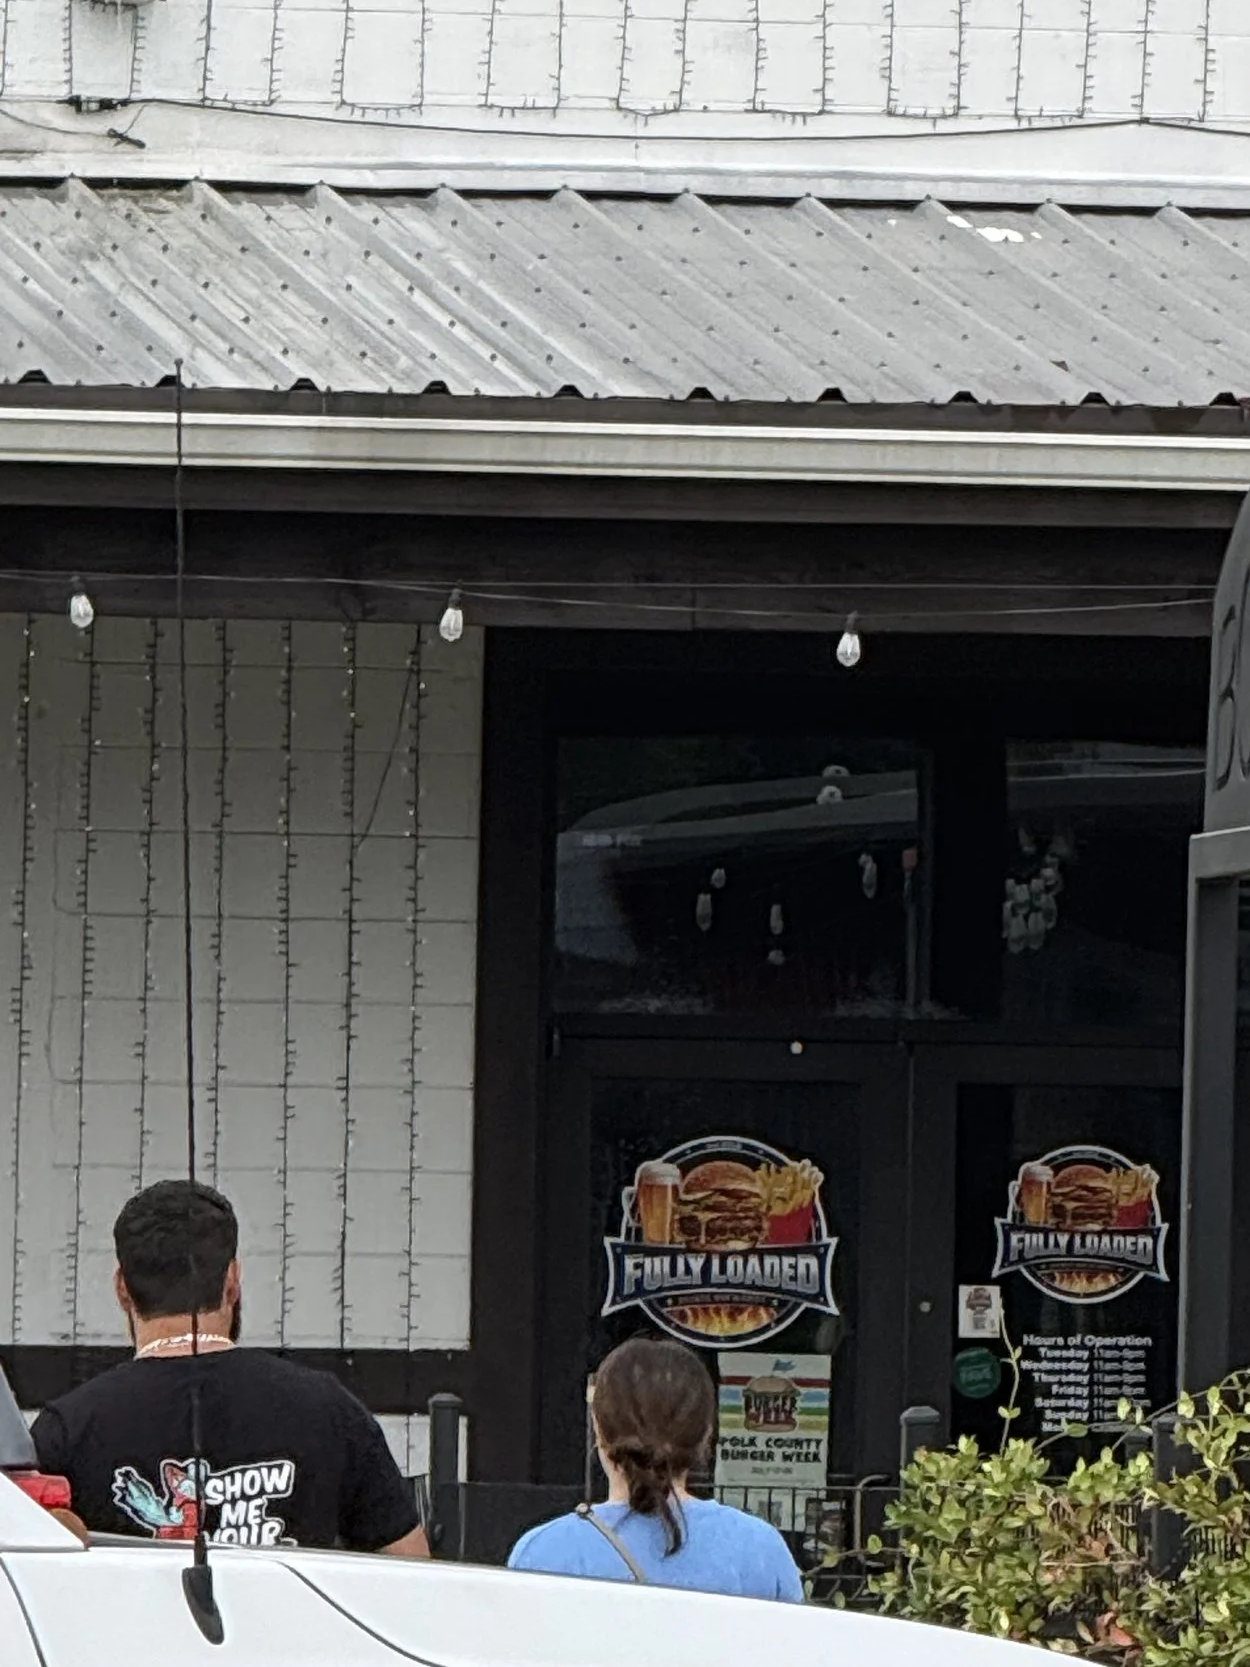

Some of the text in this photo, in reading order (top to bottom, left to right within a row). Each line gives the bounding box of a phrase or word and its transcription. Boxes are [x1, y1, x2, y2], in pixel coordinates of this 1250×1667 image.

[1009, 1231, 1154, 1265] FULLY LOADED
[623, 1252, 821, 1295] FULLY LOADED
[1022, 1334, 1152, 1348] Hours of Operation
[1038, 1347, 1090, 1360] Tuesday
[1032, 1372, 1090, 1385] Thursday
[1051, 1384, 1090, 1397] Friday
[719, 1436, 823, 1450] POLK COUNTY
[720, 1449, 822, 1463] BURGER WEEK
[204, 1462, 291, 1506] SHOW
[220, 1497, 265, 1529] ME
